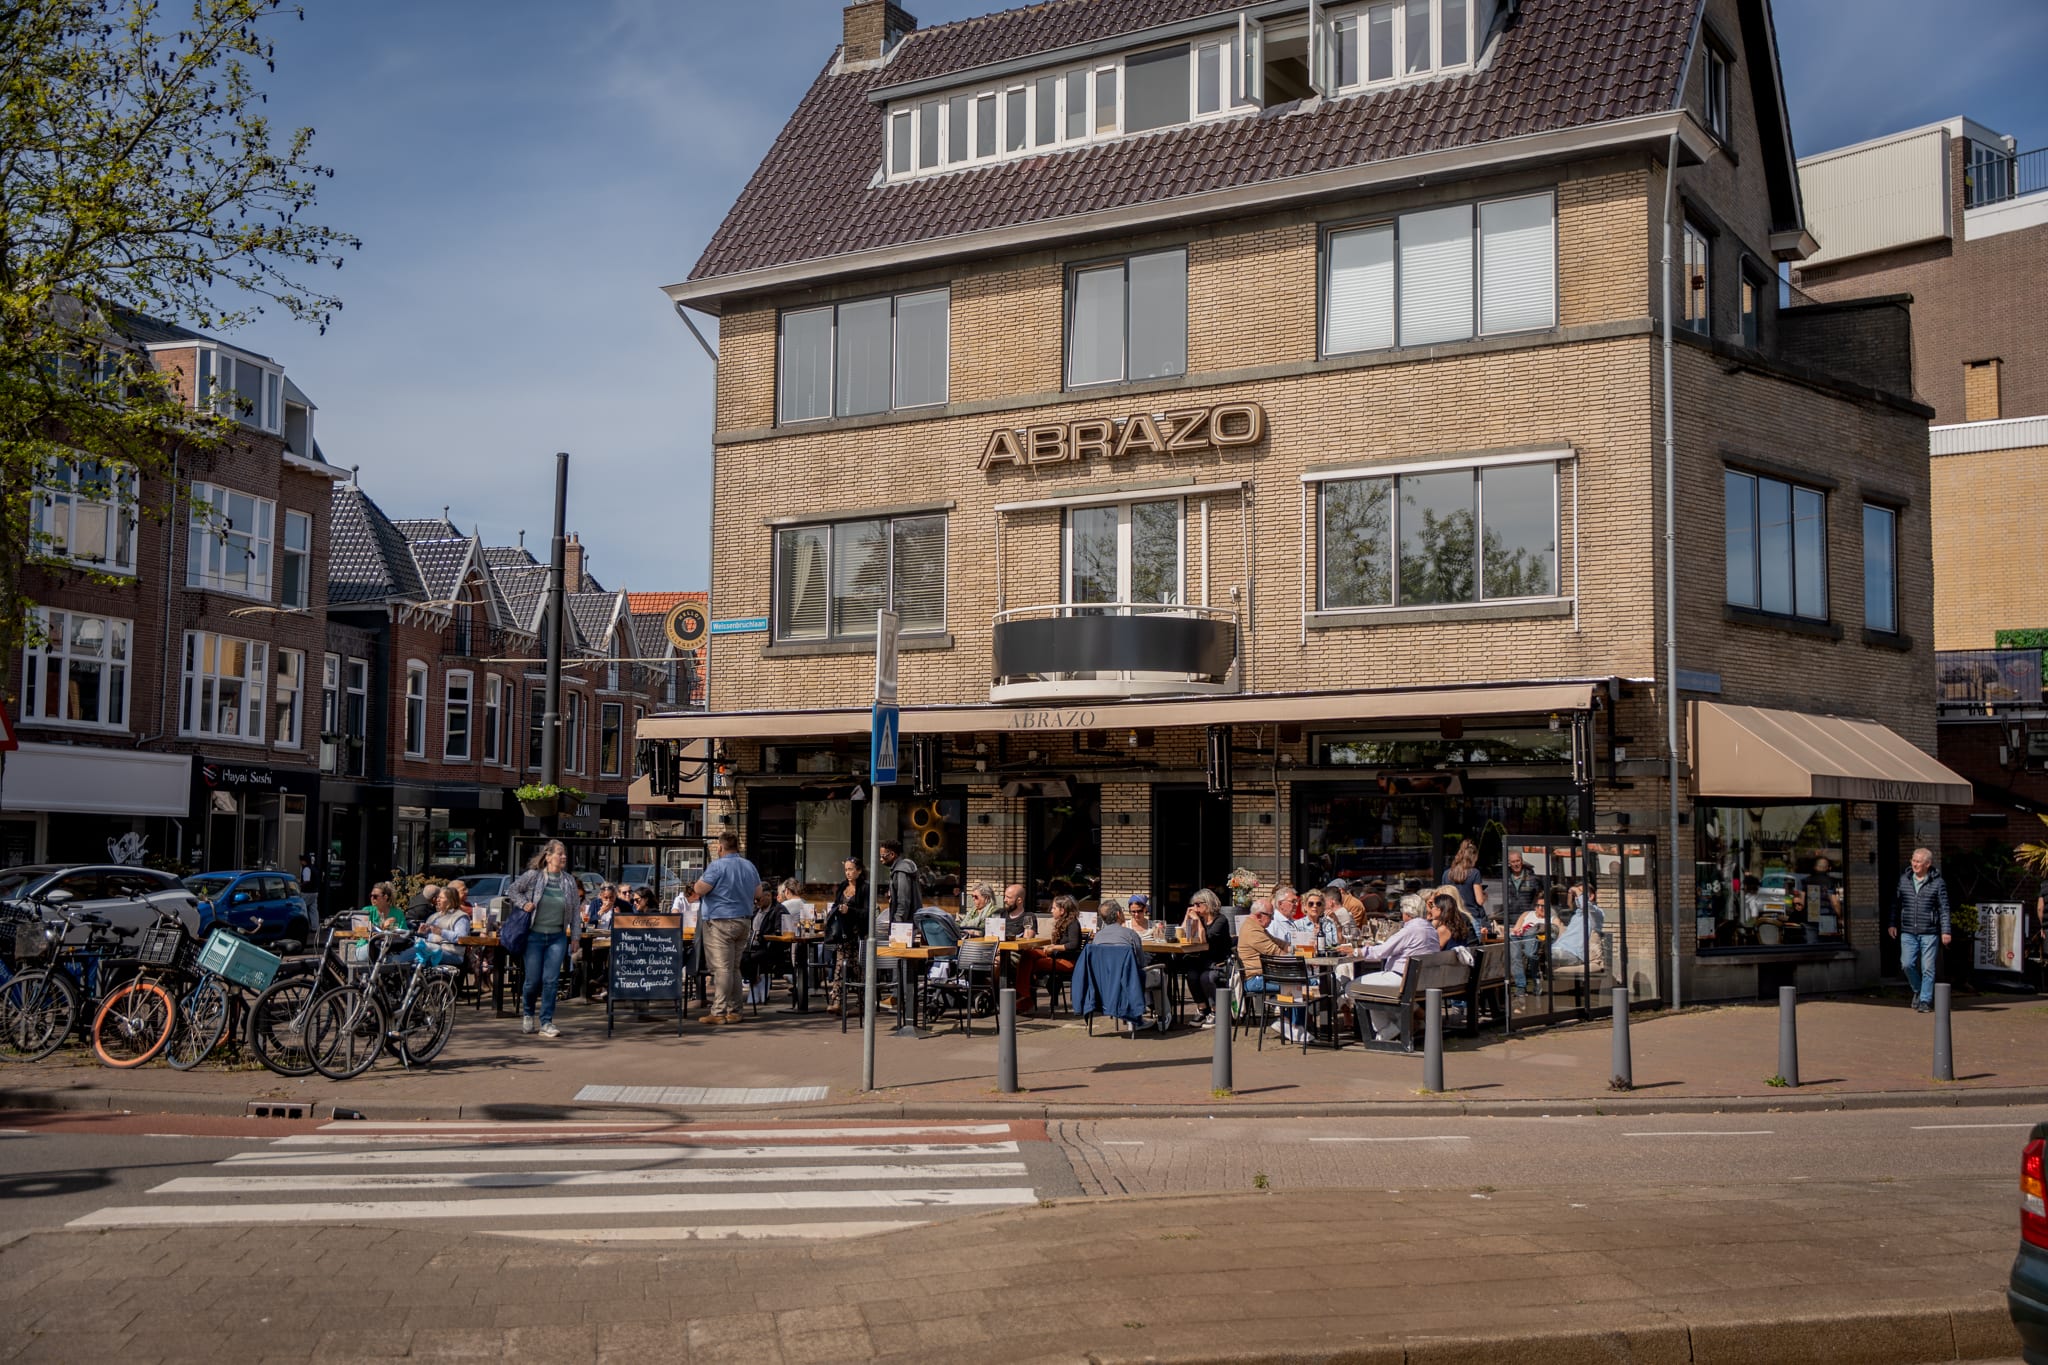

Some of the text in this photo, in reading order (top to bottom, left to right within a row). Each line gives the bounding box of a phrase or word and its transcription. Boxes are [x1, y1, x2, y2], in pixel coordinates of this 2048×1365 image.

[977, 401, 1266, 469] ABRAZO
[713, 621, 765, 630] Weissenbruchlaan
[1008, 711, 1095, 729] ABRAZO
[222, 769, 273, 785] Hayai Sushi
[1872, 782, 1920, 800] ABRAZO
